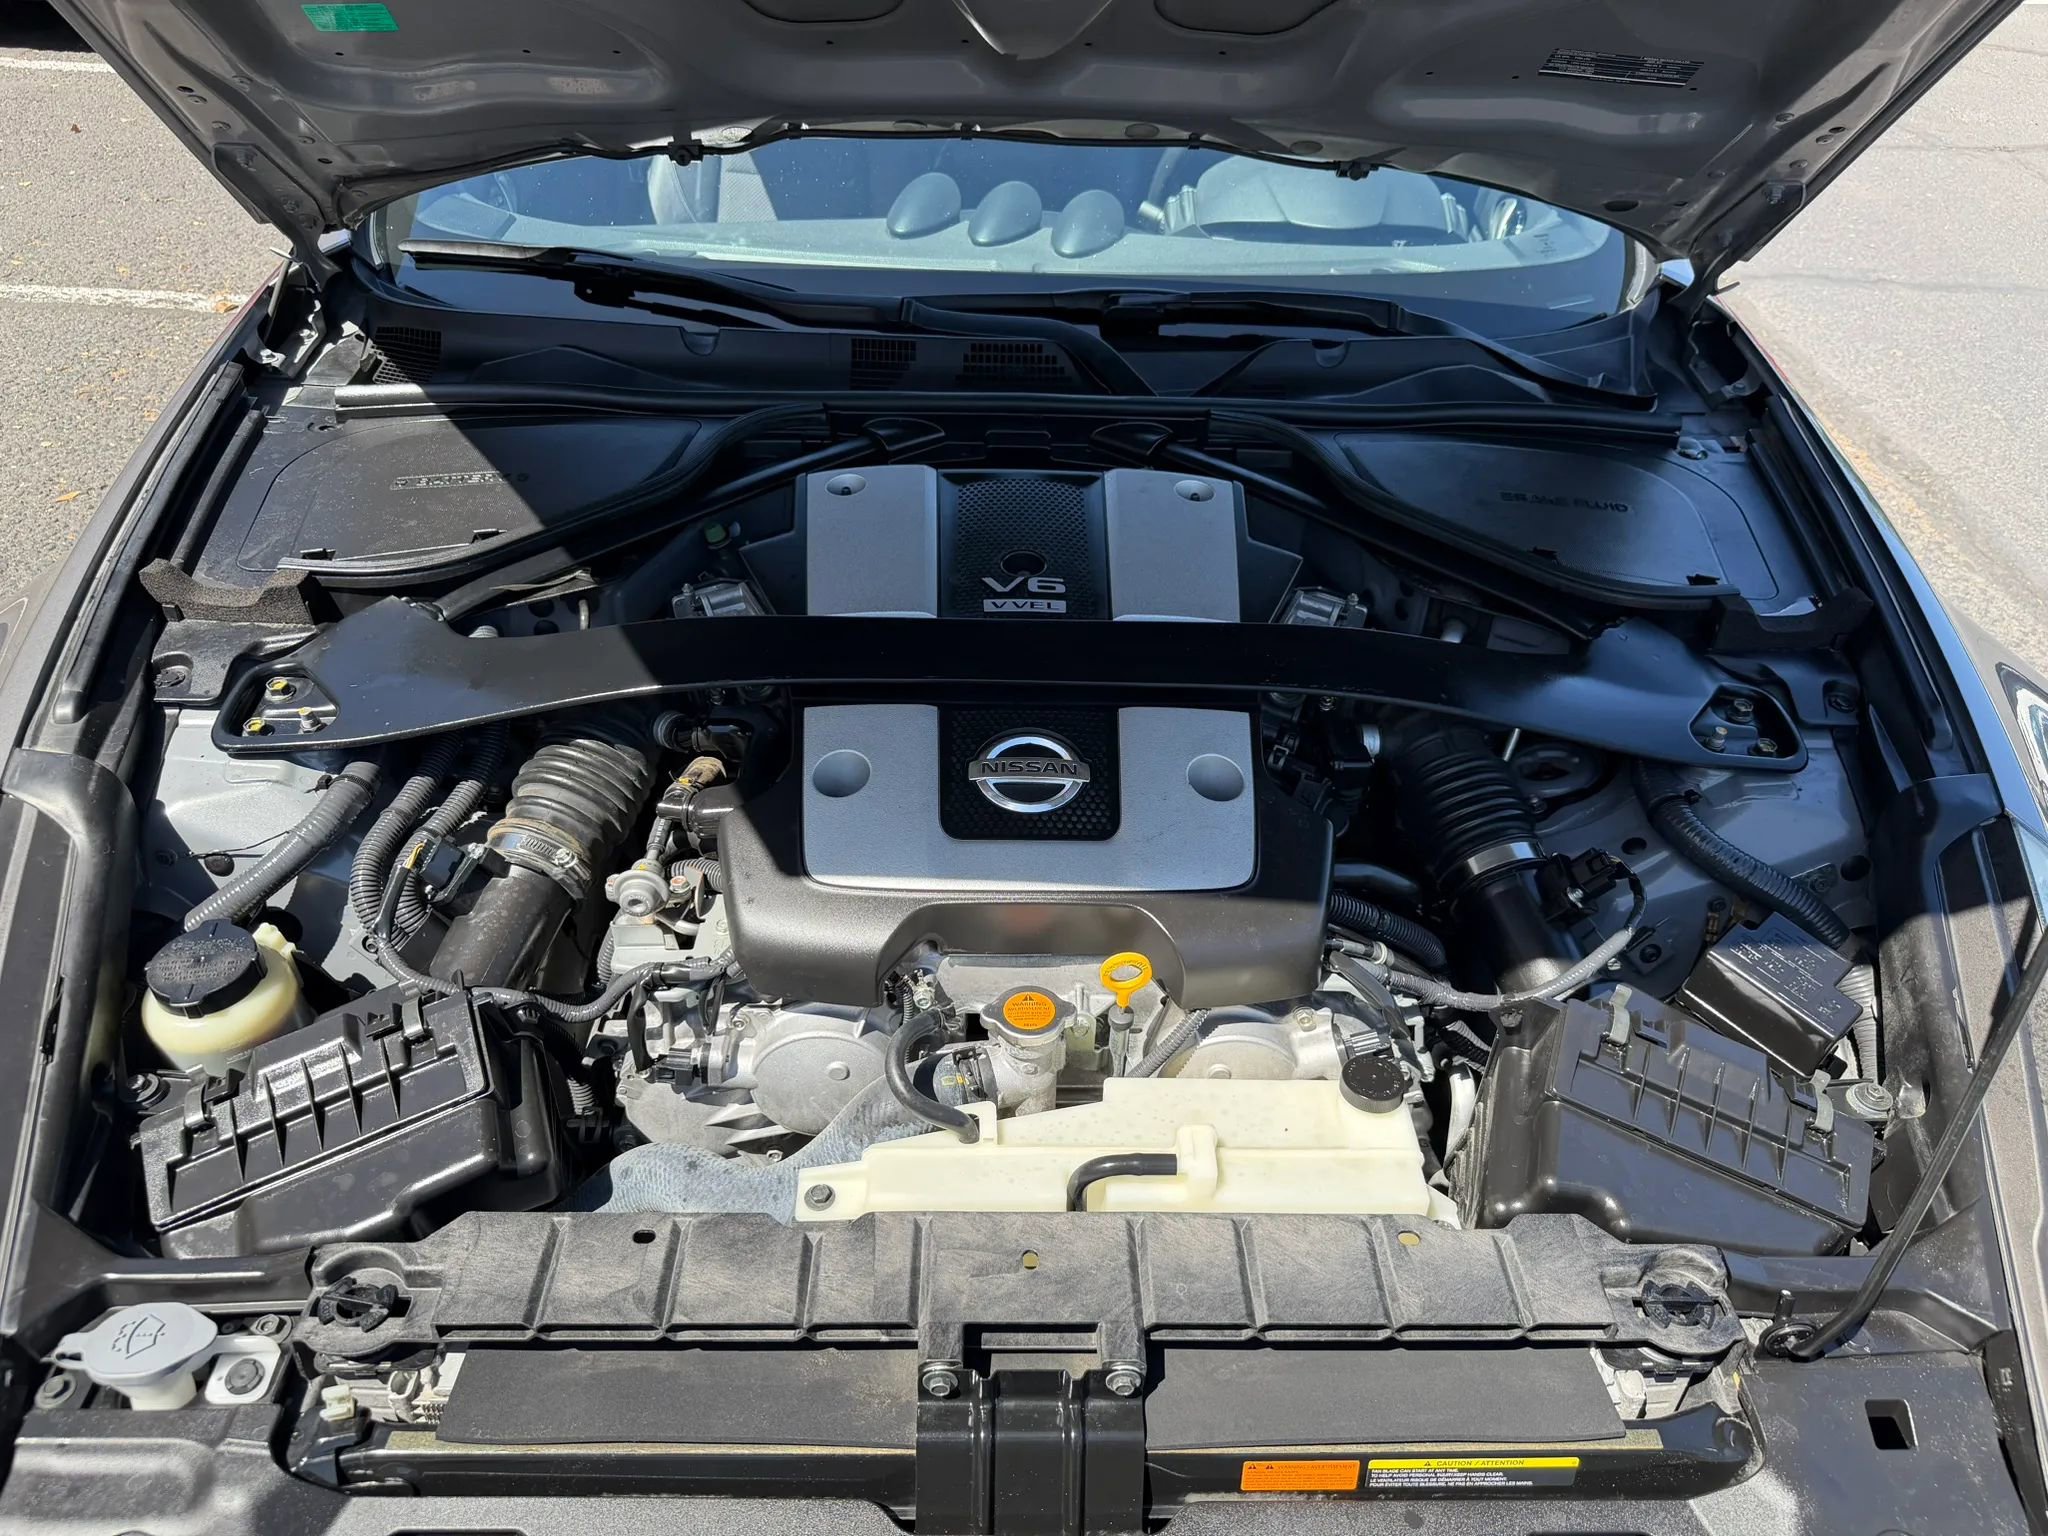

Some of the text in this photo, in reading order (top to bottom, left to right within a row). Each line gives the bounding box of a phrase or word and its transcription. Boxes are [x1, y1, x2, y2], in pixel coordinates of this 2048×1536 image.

[981, 576, 1066, 593] V6
[991, 601, 1060, 610] VVEL
[981, 761, 1077, 775] NISSAN
